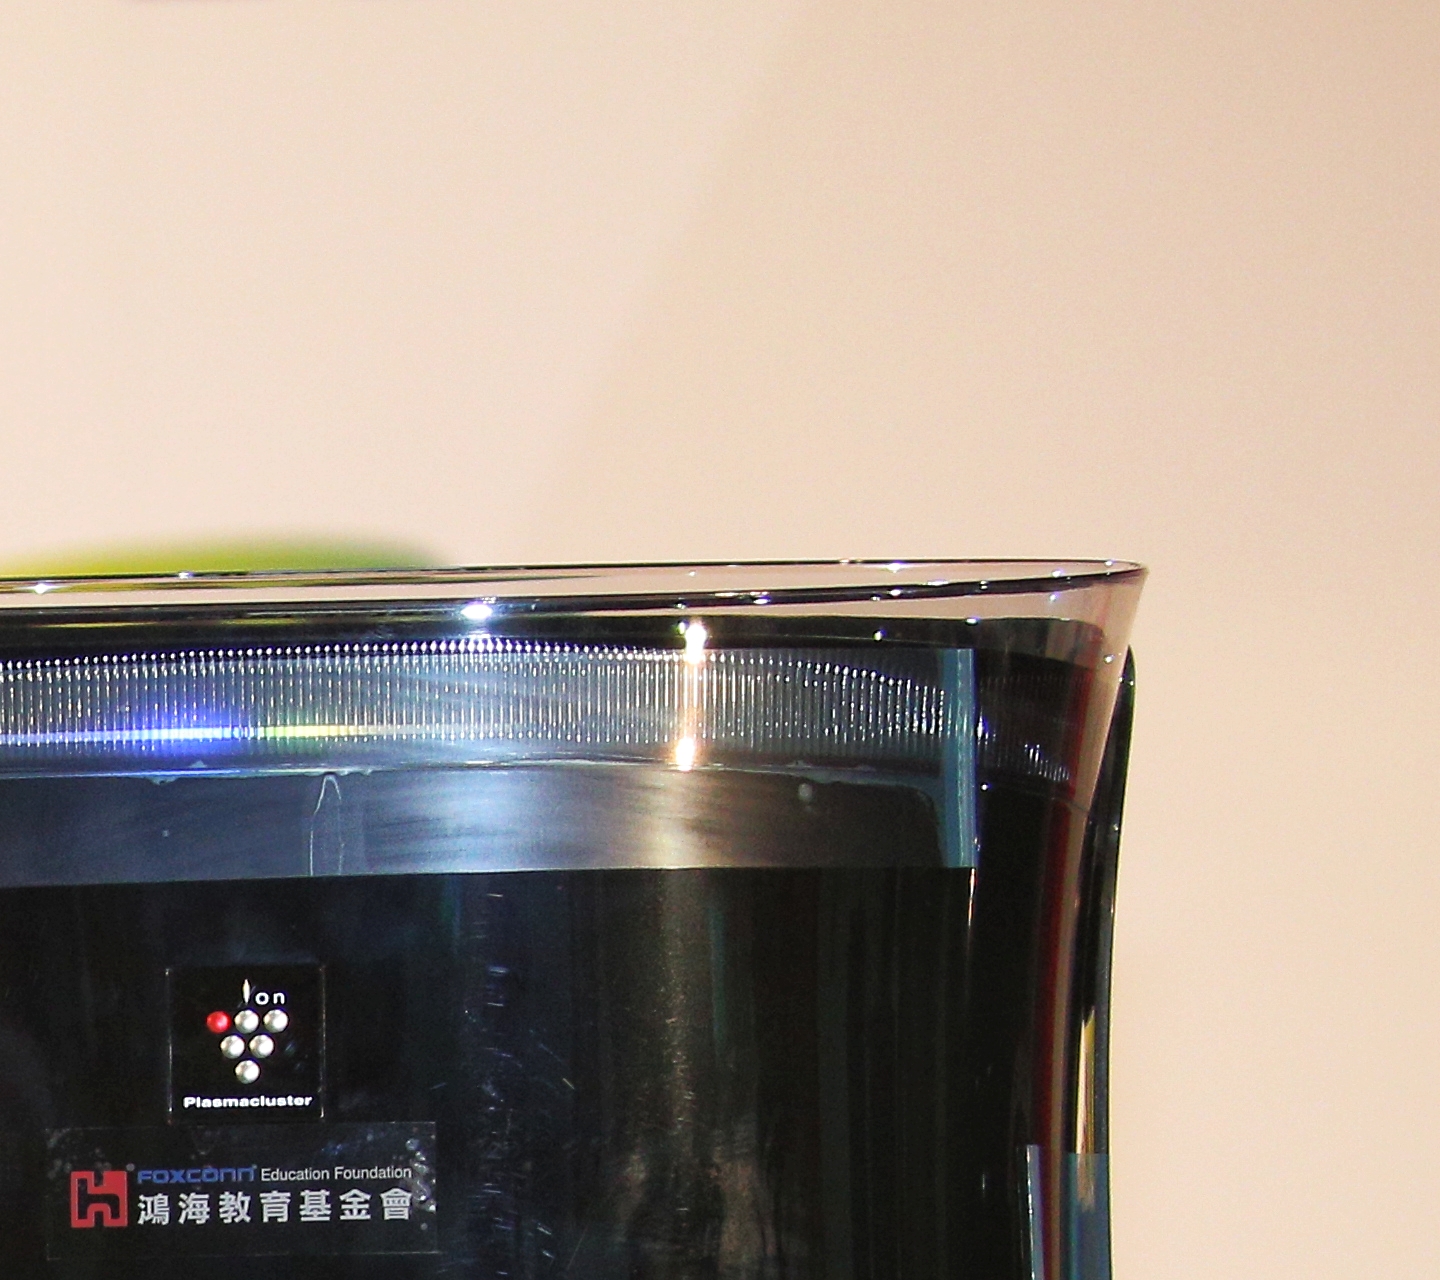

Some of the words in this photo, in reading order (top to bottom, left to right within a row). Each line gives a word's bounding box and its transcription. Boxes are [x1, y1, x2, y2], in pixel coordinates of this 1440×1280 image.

[183, 1095, 314, 1109] Plasmacluster
[261, 1167, 330, 1183] Education
[334, 1166, 413, 1182] Foundation
[137, 1188, 414, 1226] 鴻海教育基金會
